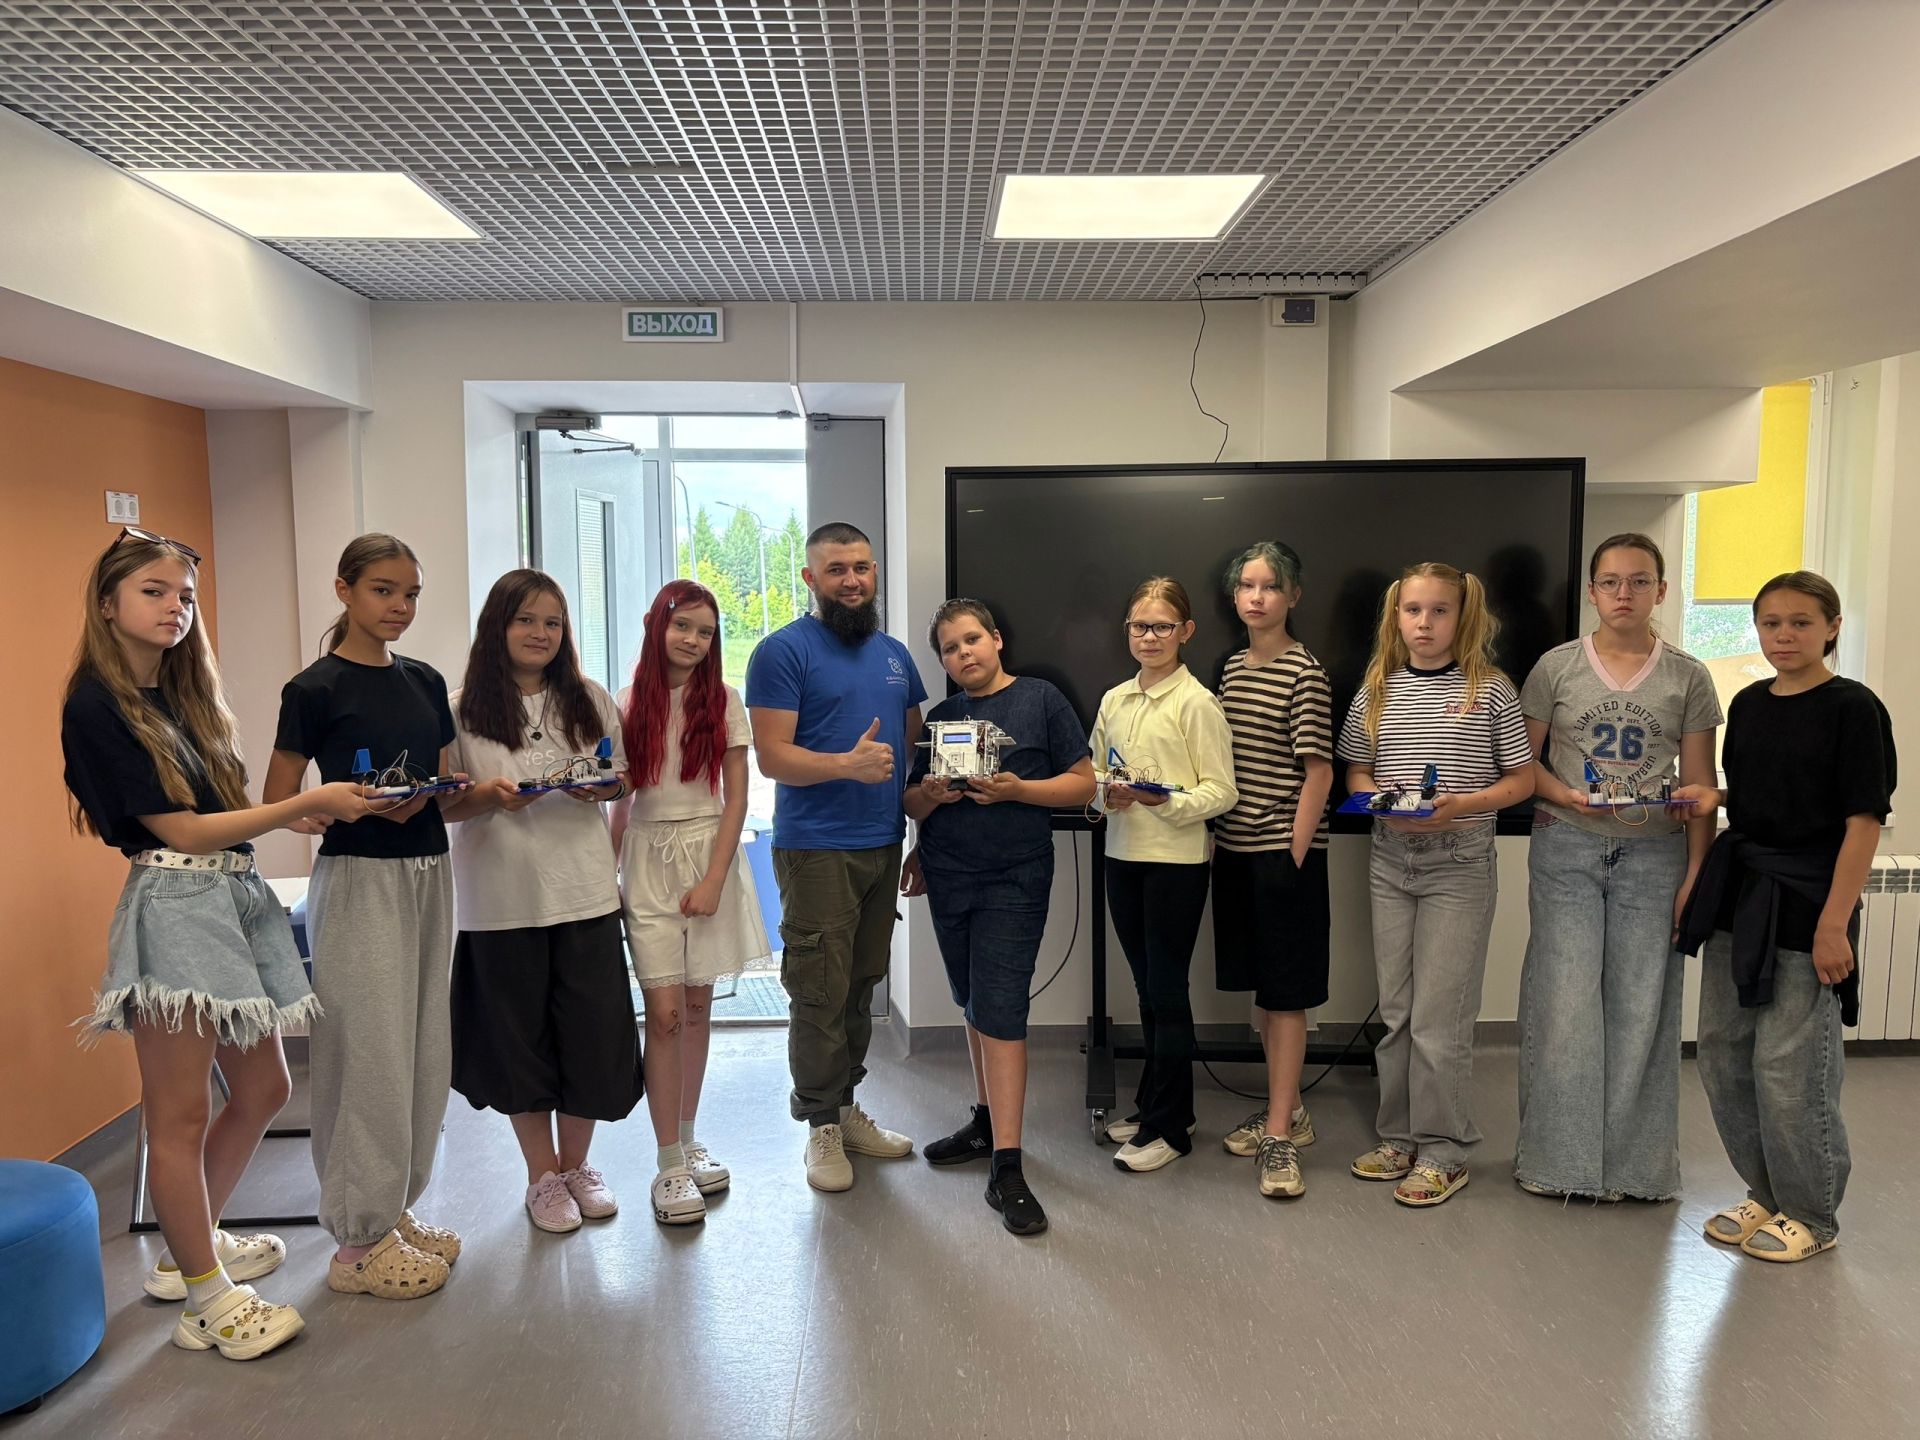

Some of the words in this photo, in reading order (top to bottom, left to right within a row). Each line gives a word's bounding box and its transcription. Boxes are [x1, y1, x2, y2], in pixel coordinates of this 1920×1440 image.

[632, 314, 713, 334] ВЫХОД
[1574, 700, 1619, 732] LIMITED
[1624, 701, 1663, 737] EDITION
[1591, 722, 1646, 760] 26
[1627, 755, 1657, 784] URBAN
